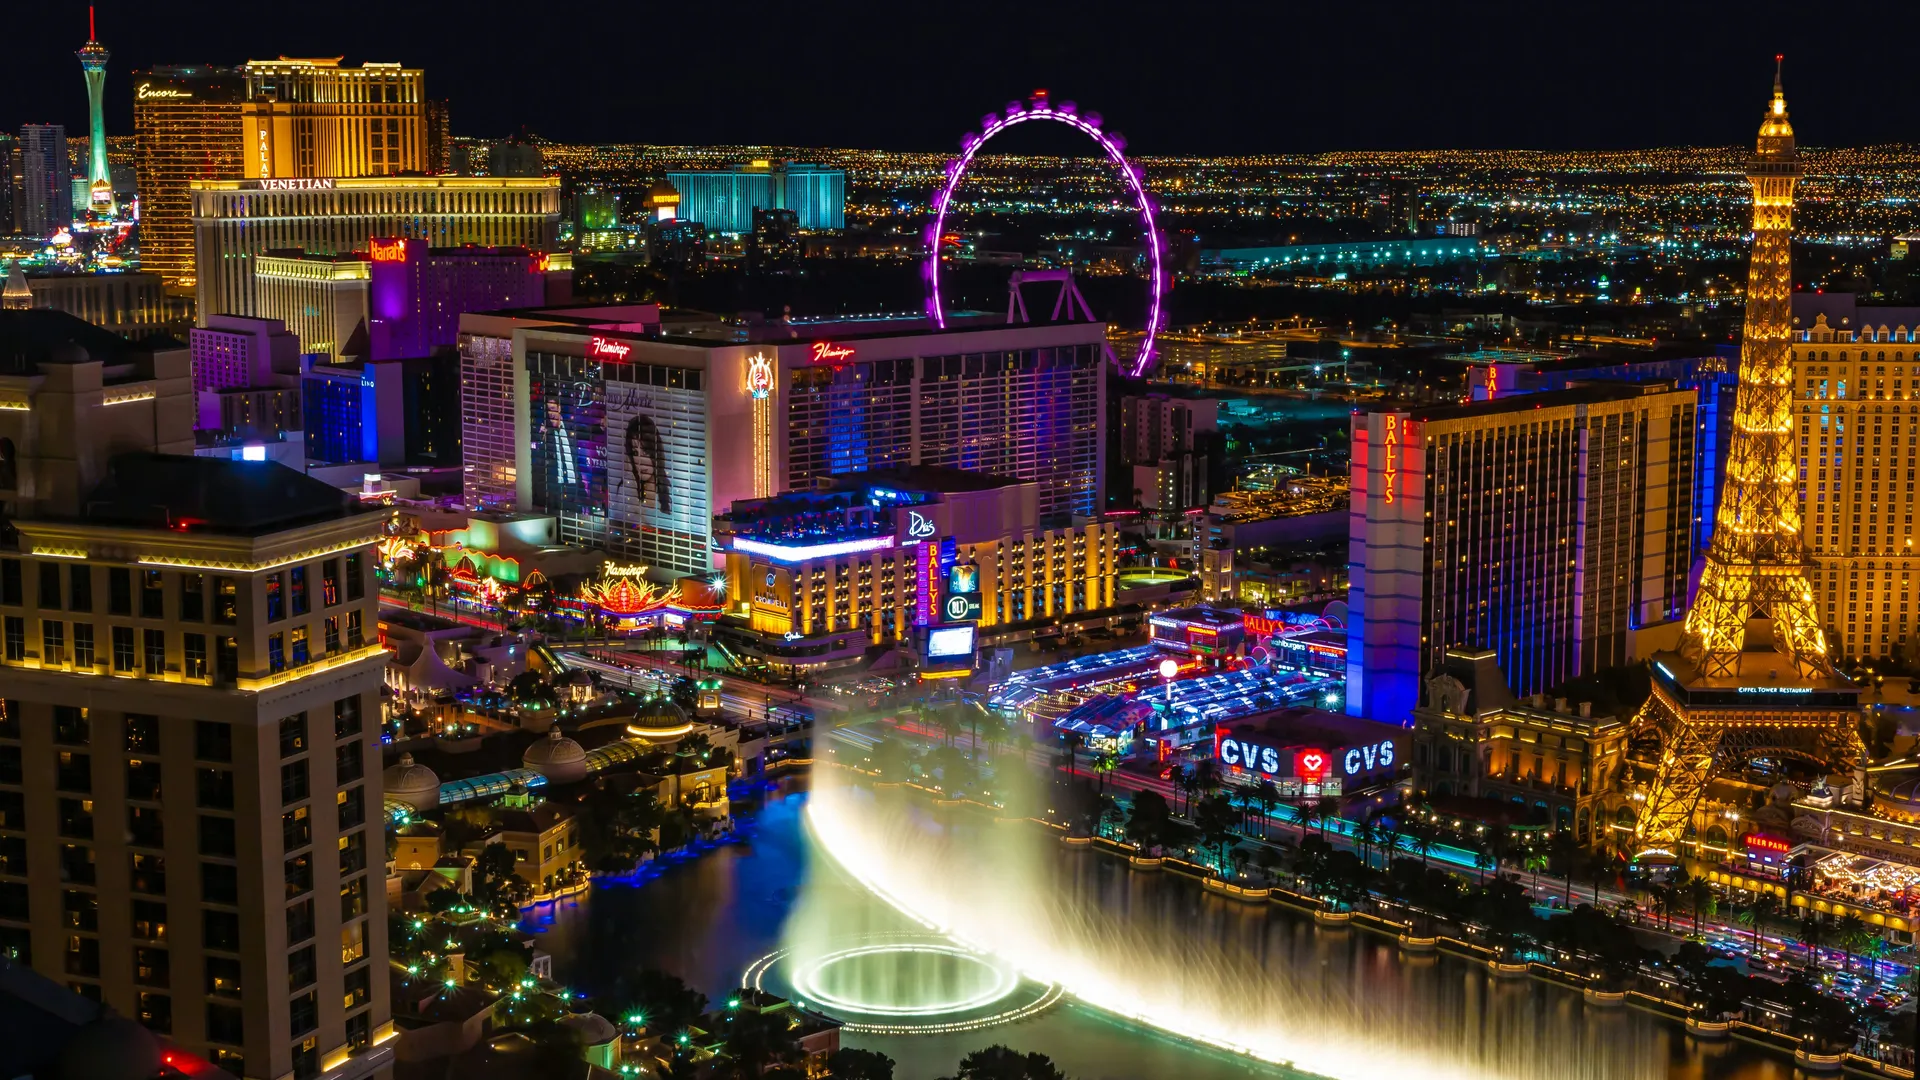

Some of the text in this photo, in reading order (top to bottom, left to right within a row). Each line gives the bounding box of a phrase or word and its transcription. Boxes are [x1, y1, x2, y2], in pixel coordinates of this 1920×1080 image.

[139, 83, 192, 99] Encore
[260, 178, 332, 190] VENETIAN
[593, 337, 630, 360] Flamingo
[813, 342, 855, 361] Flamingo
[1384, 415, 1397, 504] BALLYS
[605, 561, 648, 579] Flamingo
[929, 545, 938, 615] BALLYS
[952, 600, 964, 614] BLT
[1244, 614, 1285, 633] BALLY'S
[1271, 639, 1306, 651] wahlburgers
[1221, 738, 1279, 774] CVS
[1345, 740, 1394, 775] CVS
[1747, 836, 1788, 851] BEER PARK
